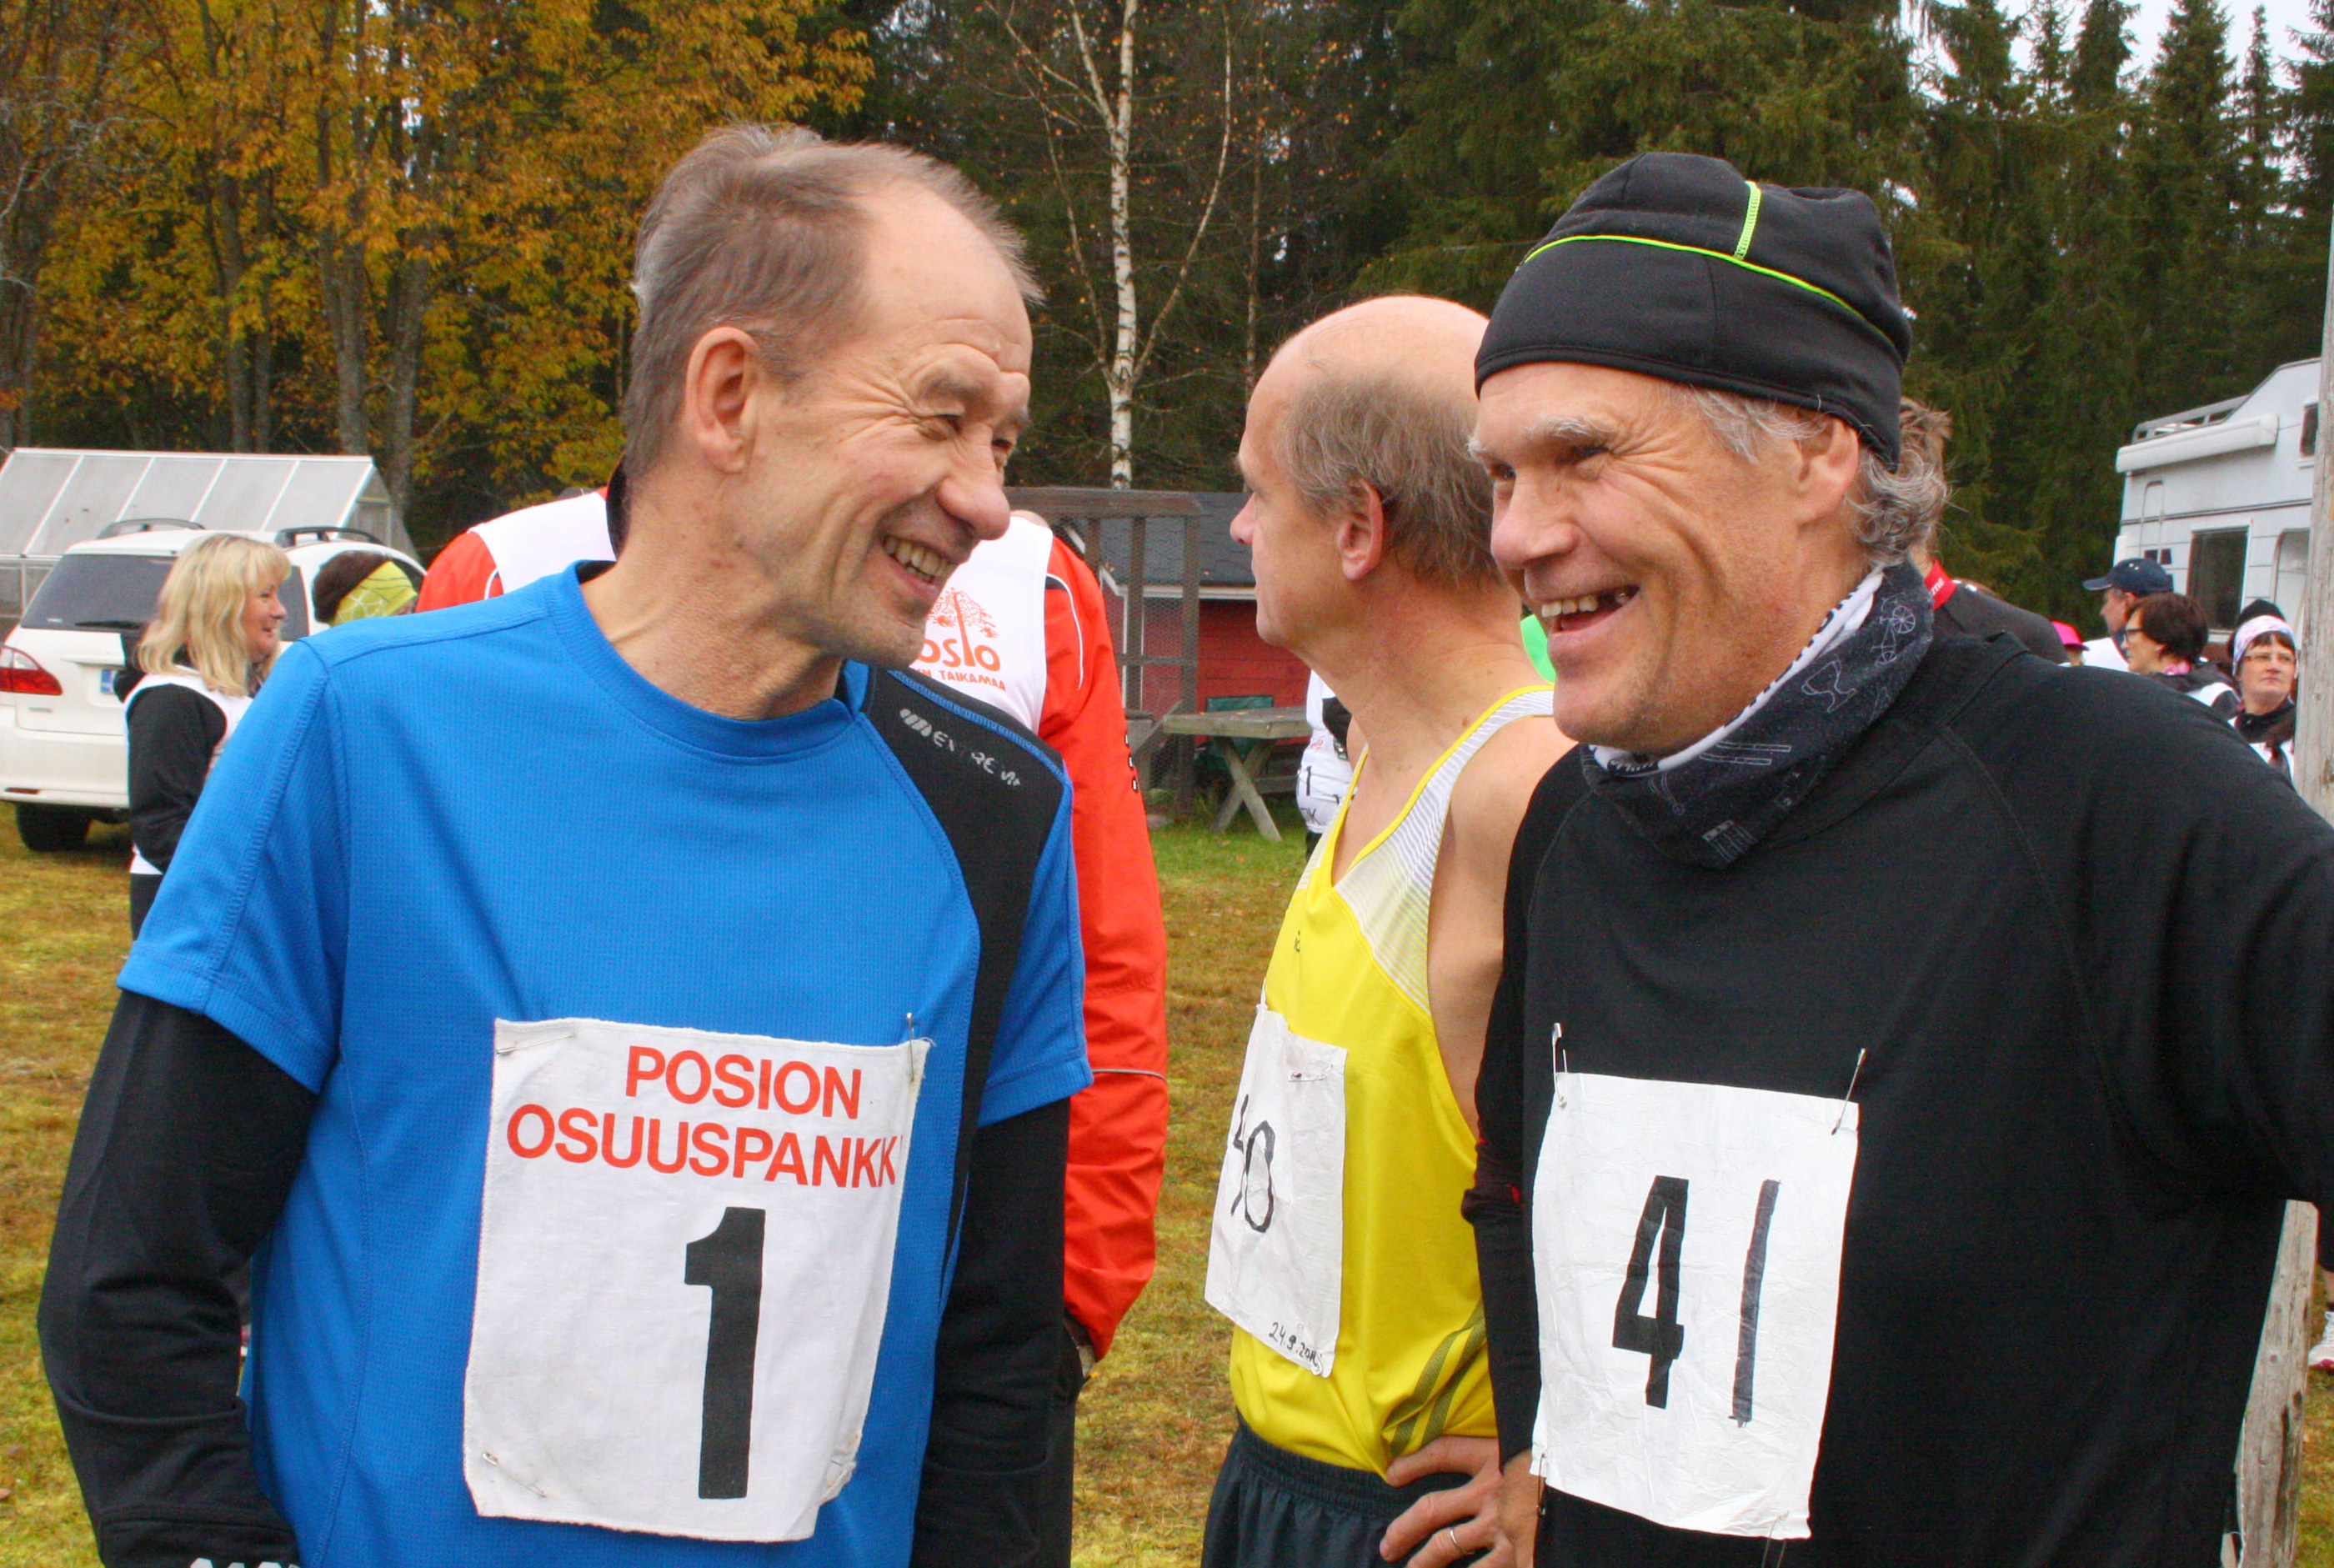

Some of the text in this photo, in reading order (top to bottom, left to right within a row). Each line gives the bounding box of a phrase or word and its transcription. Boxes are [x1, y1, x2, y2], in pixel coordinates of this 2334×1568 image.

[939, 669, 1007, 692] TAIKAMAA
[625, 1044, 862, 1120] POSION
[507, 1103, 903, 1189] OSUUSPANKK
[1612, 1175, 1782, 1428] 41
[684, 1206, 766, 1500] 1
